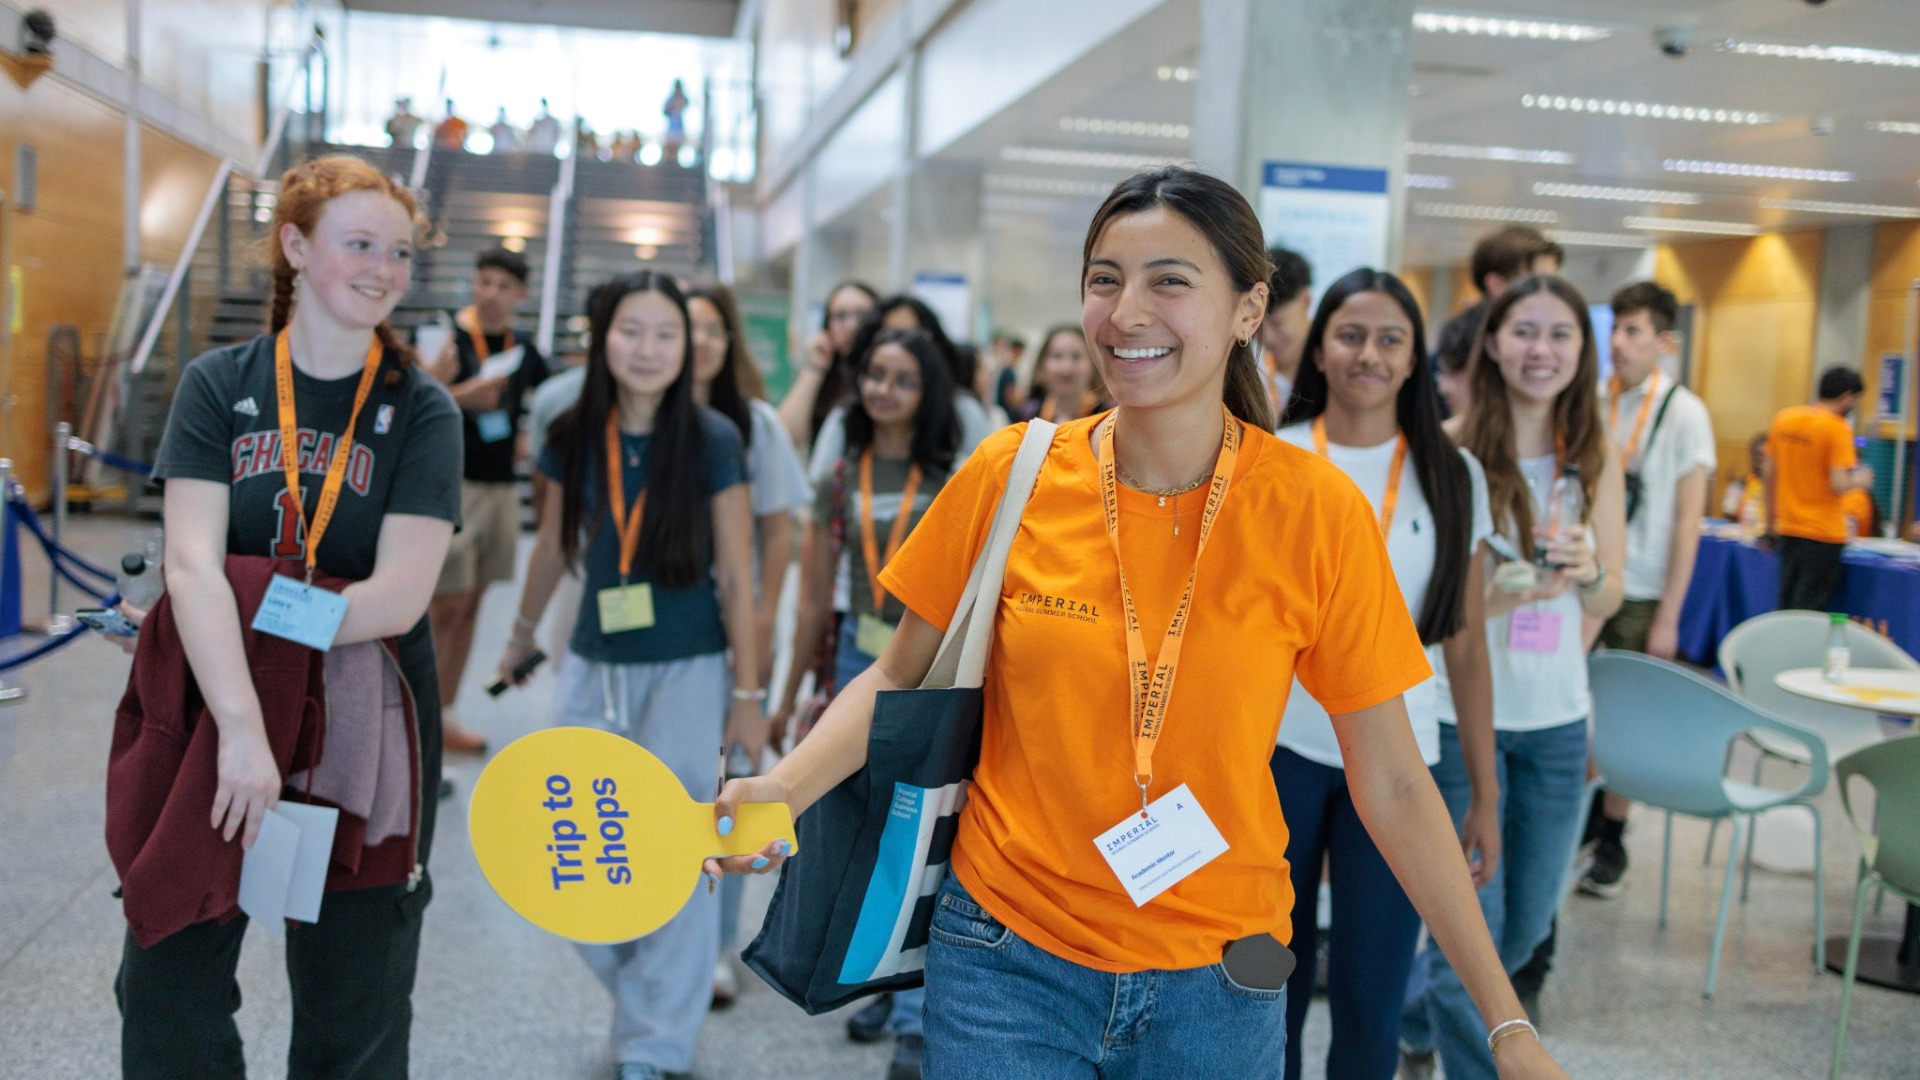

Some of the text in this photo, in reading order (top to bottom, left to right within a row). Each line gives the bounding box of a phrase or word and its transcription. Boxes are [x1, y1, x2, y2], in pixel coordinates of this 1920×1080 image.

[231, 427, 374, 496] CHCAO
[270, 486, 308, 560] 1
[1105, 463, 1117, 533] IMPERIAL
[1020, 593, 1100, 617] IMPERIAL
[1035, 608, 1066, 617] SUMMER
[1067, 612, 1098, 624] SCHOOL
[1142, 664, 1168, 738] IMPERIAL
[1152, 666, 1174, 740] GLOBAL SUMMER SCHOOL
[542, 774, 587, 890] Trip to
[592, 777, 632, 885] shops
[891, 808, 912, 819] School
[1106, 816, 1158, 851] IMPERIAL
[1131, 850, 1175, 880] Academic Mentor
